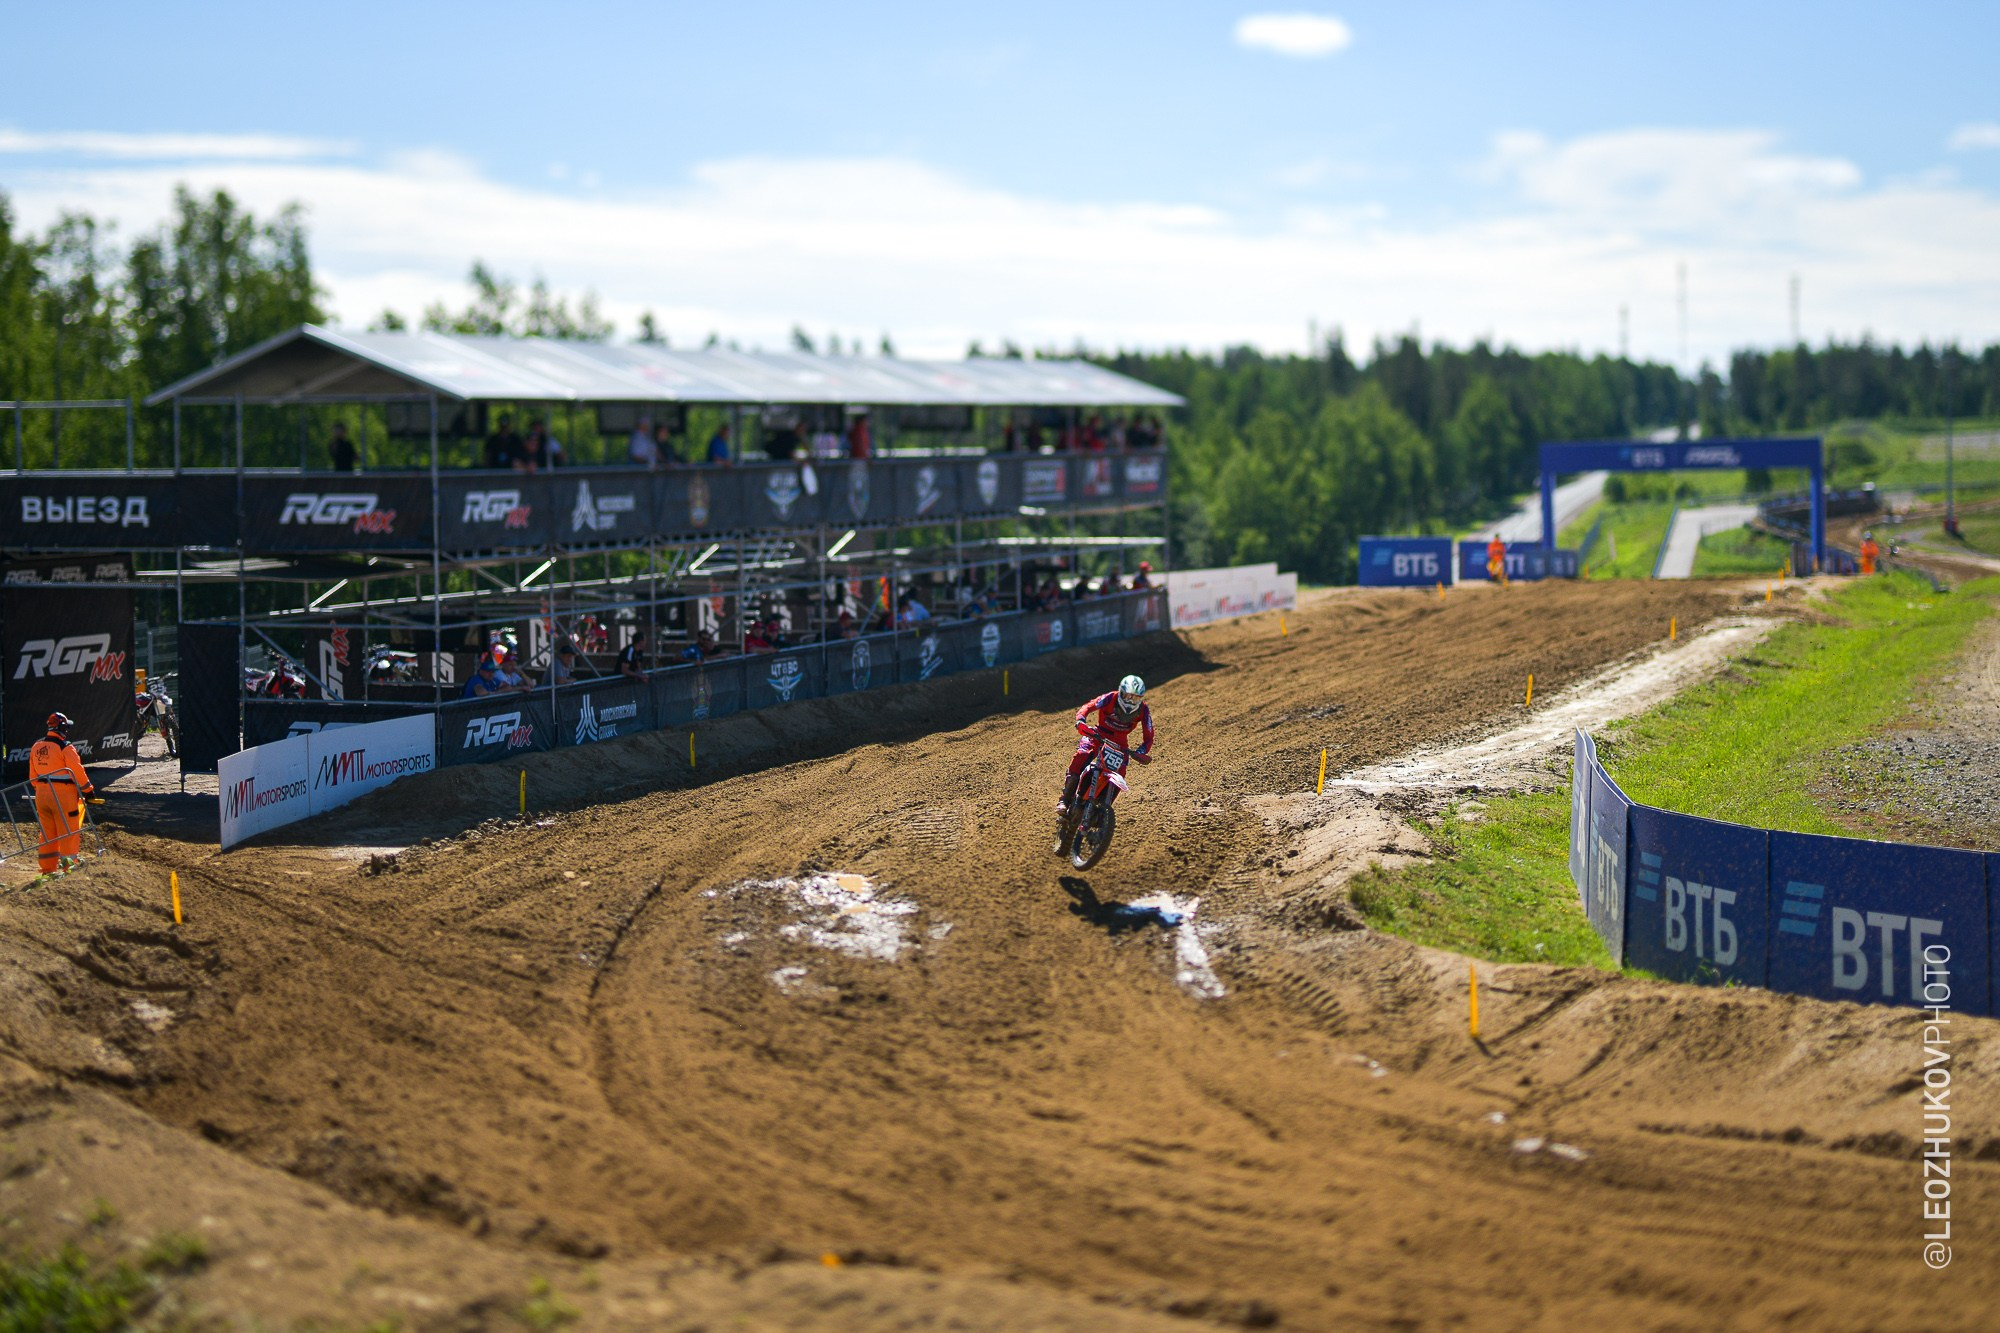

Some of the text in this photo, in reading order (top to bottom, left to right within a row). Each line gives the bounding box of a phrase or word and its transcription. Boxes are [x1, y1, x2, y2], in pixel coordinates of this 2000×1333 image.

[21, 495, 149, 528] ВЫЕЗД
[279, 493, 397, 535] RGP MX
[462, 489, 519, 522] RGP
[1393, 551, 1439, 577] ВТБ
[13, 633, 126, 685] RGP MX
[102, 732, 130, 750] RGP
[463, 711, 534, 750] RGP MX
[8, 747, 32, 763] RG
[364, 753, 431, 780] MOTORSPORTS
[1104, 750, 1124, 769] 758
[253, 779, 307, 811] MOTORSPORTS
[1665, 876, 1738, 967] ВТБ
[1832, 906, 1949, 1002] ВТБ
